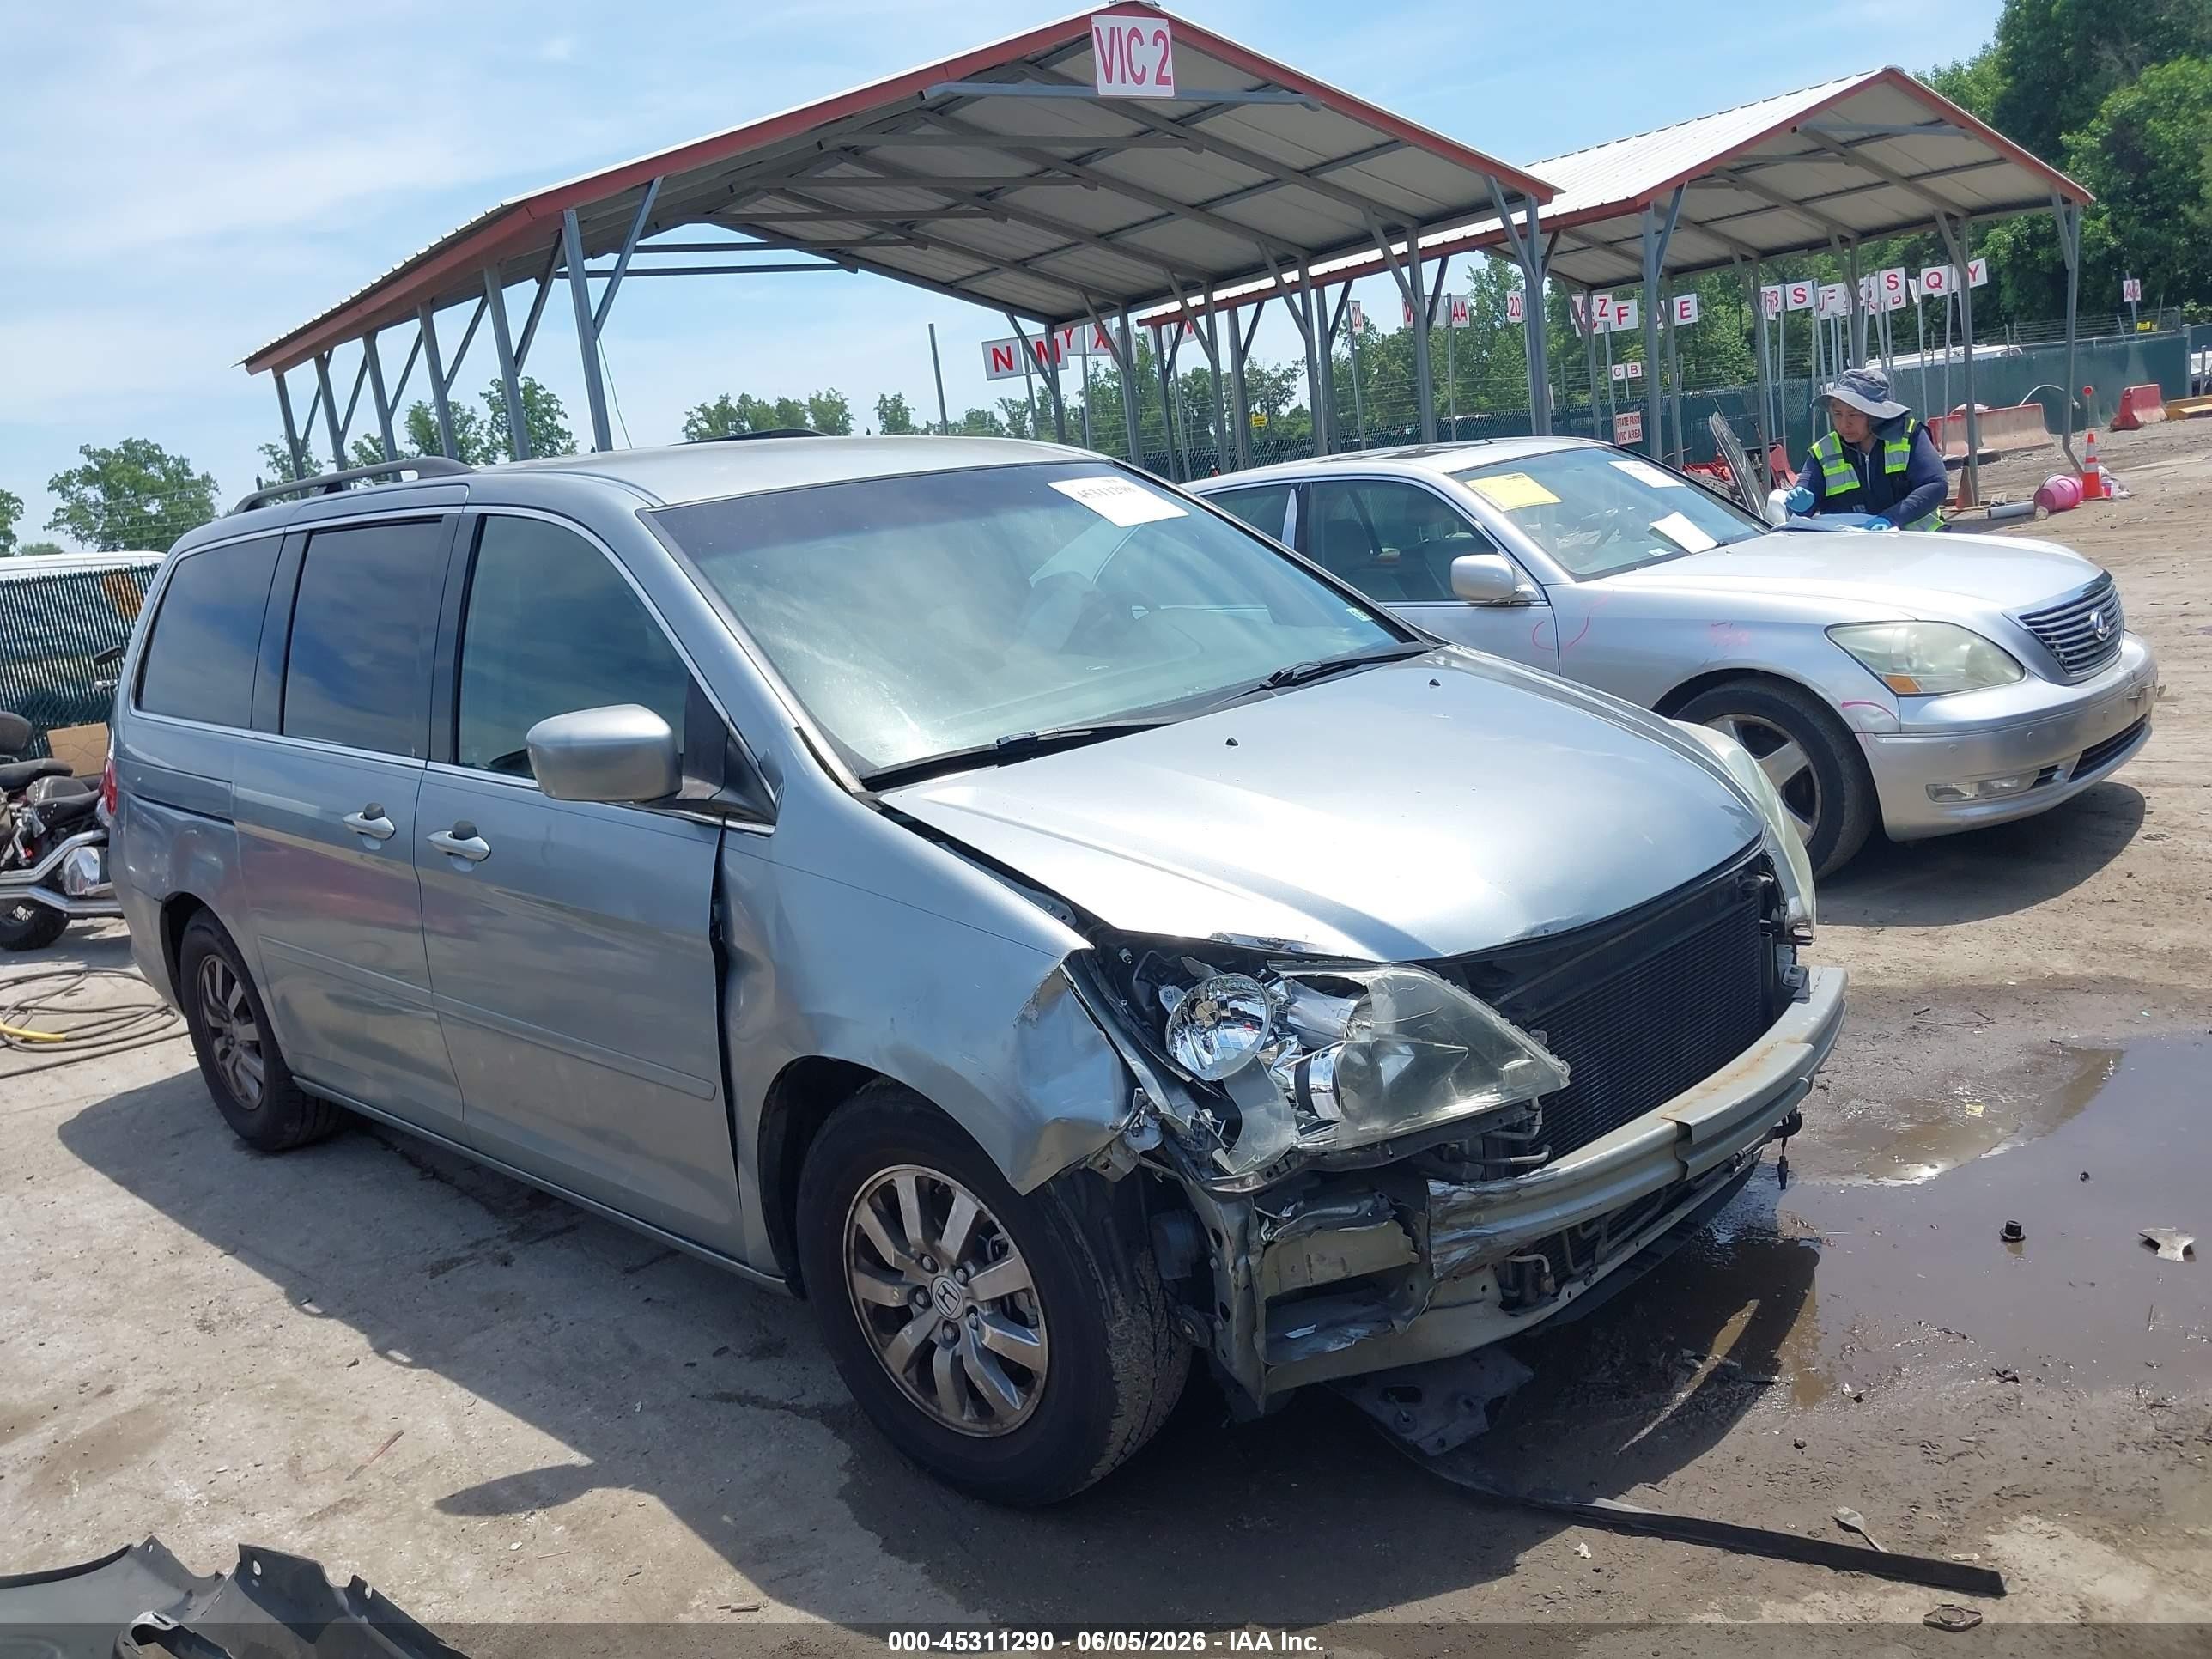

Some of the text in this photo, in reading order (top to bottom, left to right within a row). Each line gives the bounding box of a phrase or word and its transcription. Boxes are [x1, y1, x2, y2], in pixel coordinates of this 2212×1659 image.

[1094, 27, 1171, 86] VIC 2
[1887, 274, 1899, 290] S
[1926, 272, 1942, 289] Q
[1968, 264, 1979, 282] Y
[1793, 287, 1807, 304] S
[1453, 301, 1468, 321] AA
[1509, 296, 1521, 317] 20
[1598, 298, 1609, 317] Z
[1617, 306, 1629, 325] F
[1679, 300, 1692, 319] E
[992, 345, 1014, 373] N
[1614, 368, 1622, 377] C
[1631, 365, 1638, 374] B
[1616, 417, 1629, 428] STATE
[1628, 428, 1641, 441] AREA
